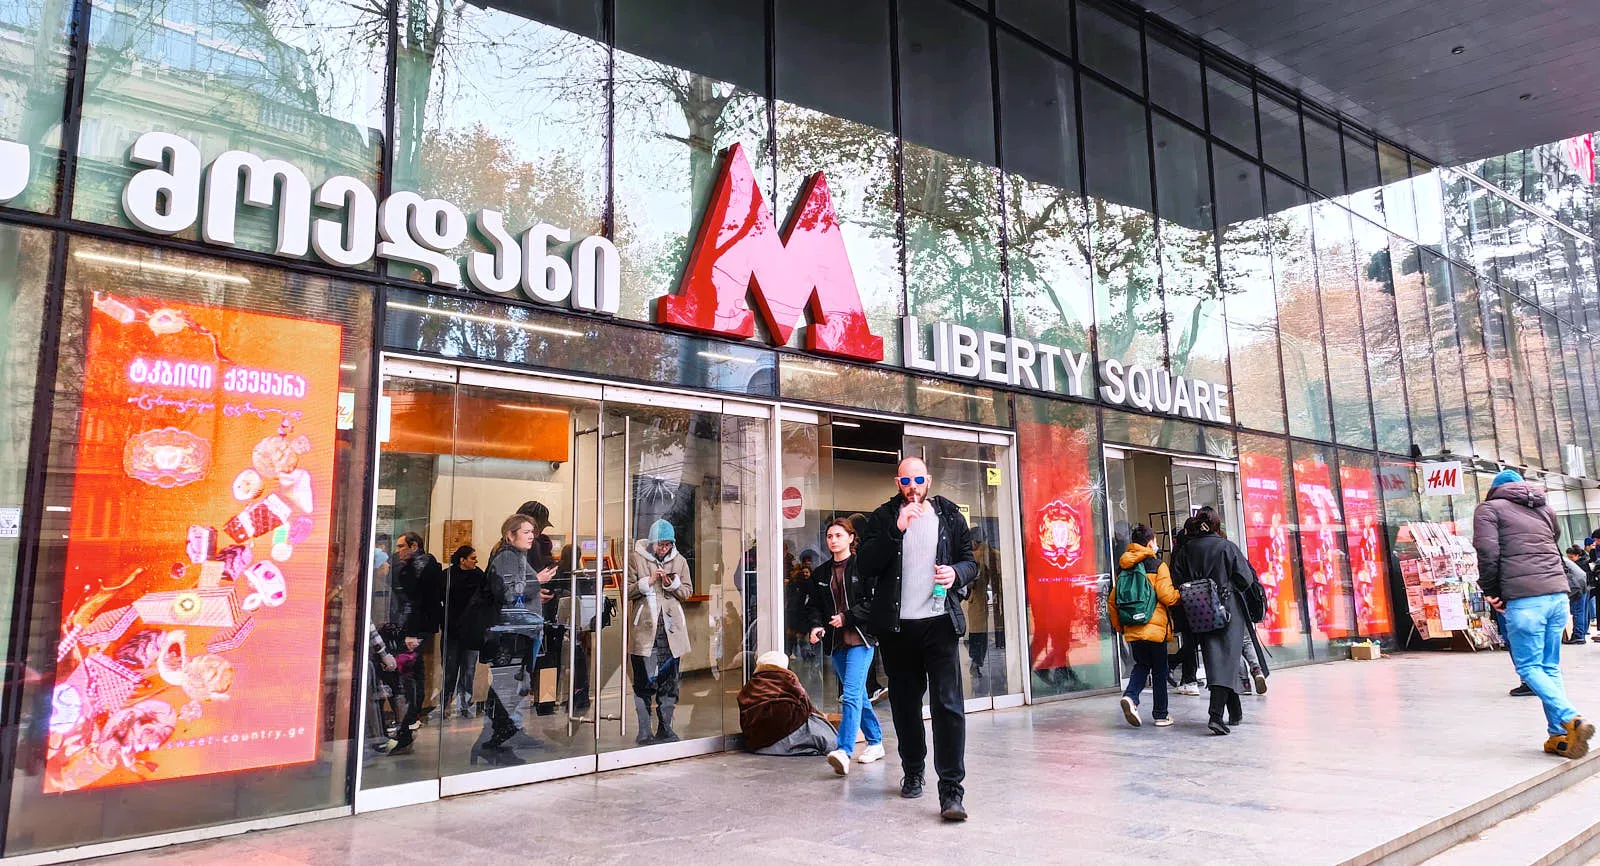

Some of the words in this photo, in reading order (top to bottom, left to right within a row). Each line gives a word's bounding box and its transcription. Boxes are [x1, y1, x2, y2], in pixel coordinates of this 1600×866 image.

[122, 131, 621, 314] მოედანი
[657, 142, 884, 362] M
[128, 357, 212, 390] ტკბილი
[223, 367, 307, 399] ქვეყანა
[902, 315, 1089, 397] LIBERTY
[1099, 358, 1232, 424] SQUARE
[1427, 468, 1457, 489] H&M
